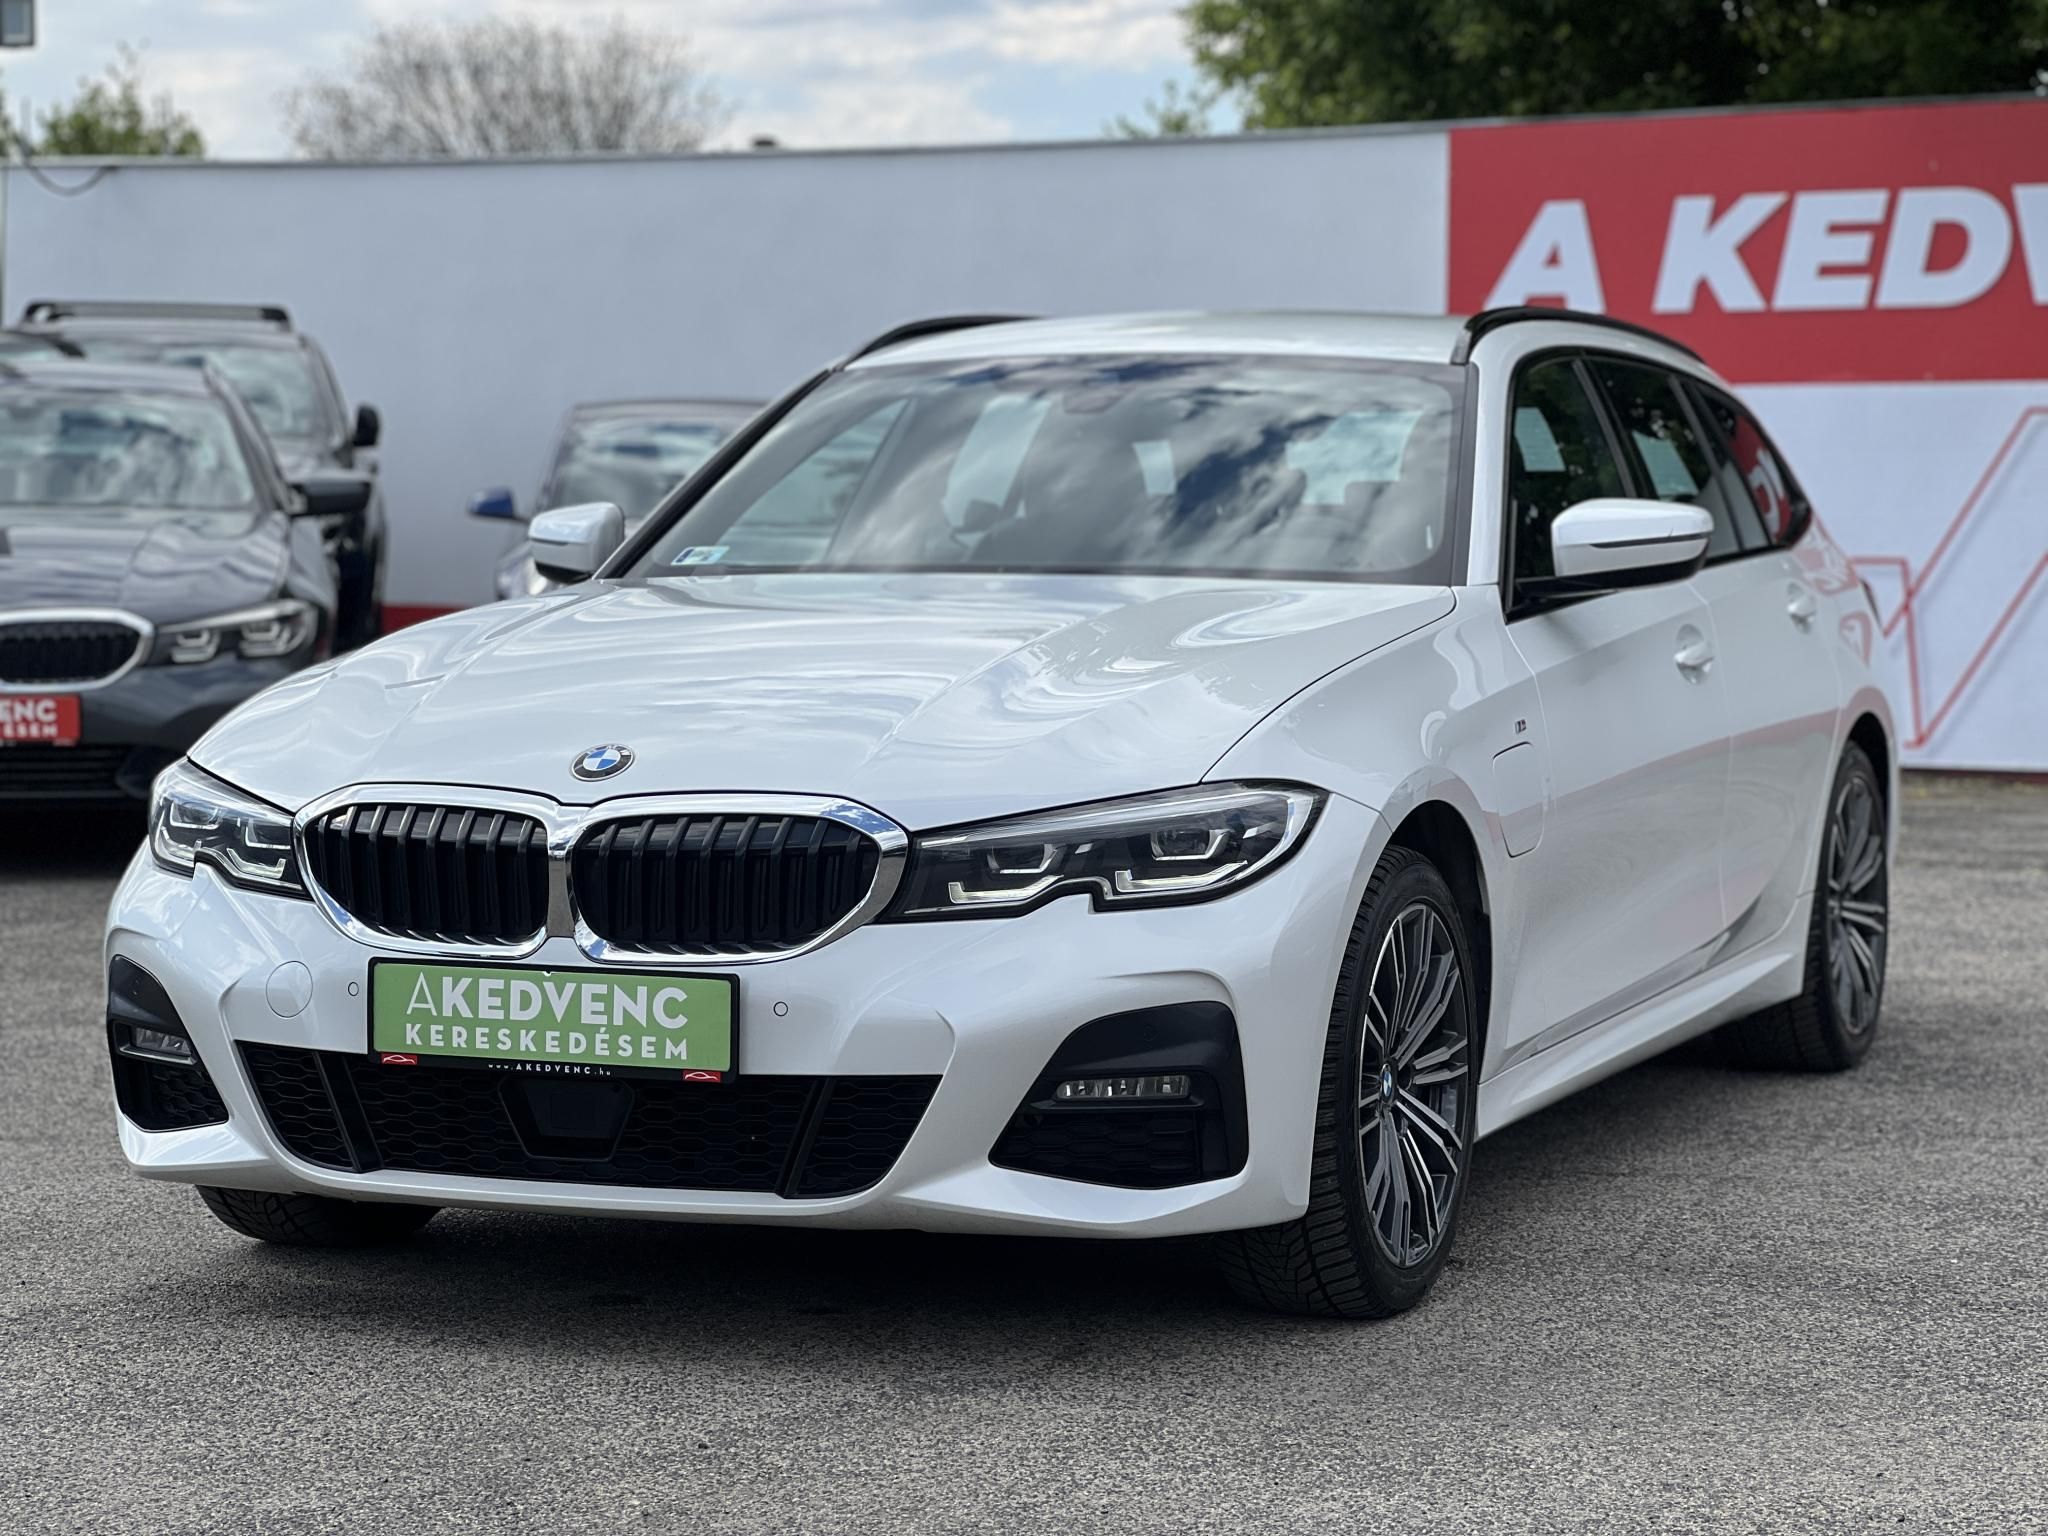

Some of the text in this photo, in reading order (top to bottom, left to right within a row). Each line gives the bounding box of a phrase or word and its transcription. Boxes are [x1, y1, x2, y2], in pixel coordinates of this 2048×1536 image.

[1483, 200, 1606, 314] A
[405, 1024, 688, 1061] KERESKEDÉSEM
[488, 1063, 611, 1076] www.AKEDVENC.hu
